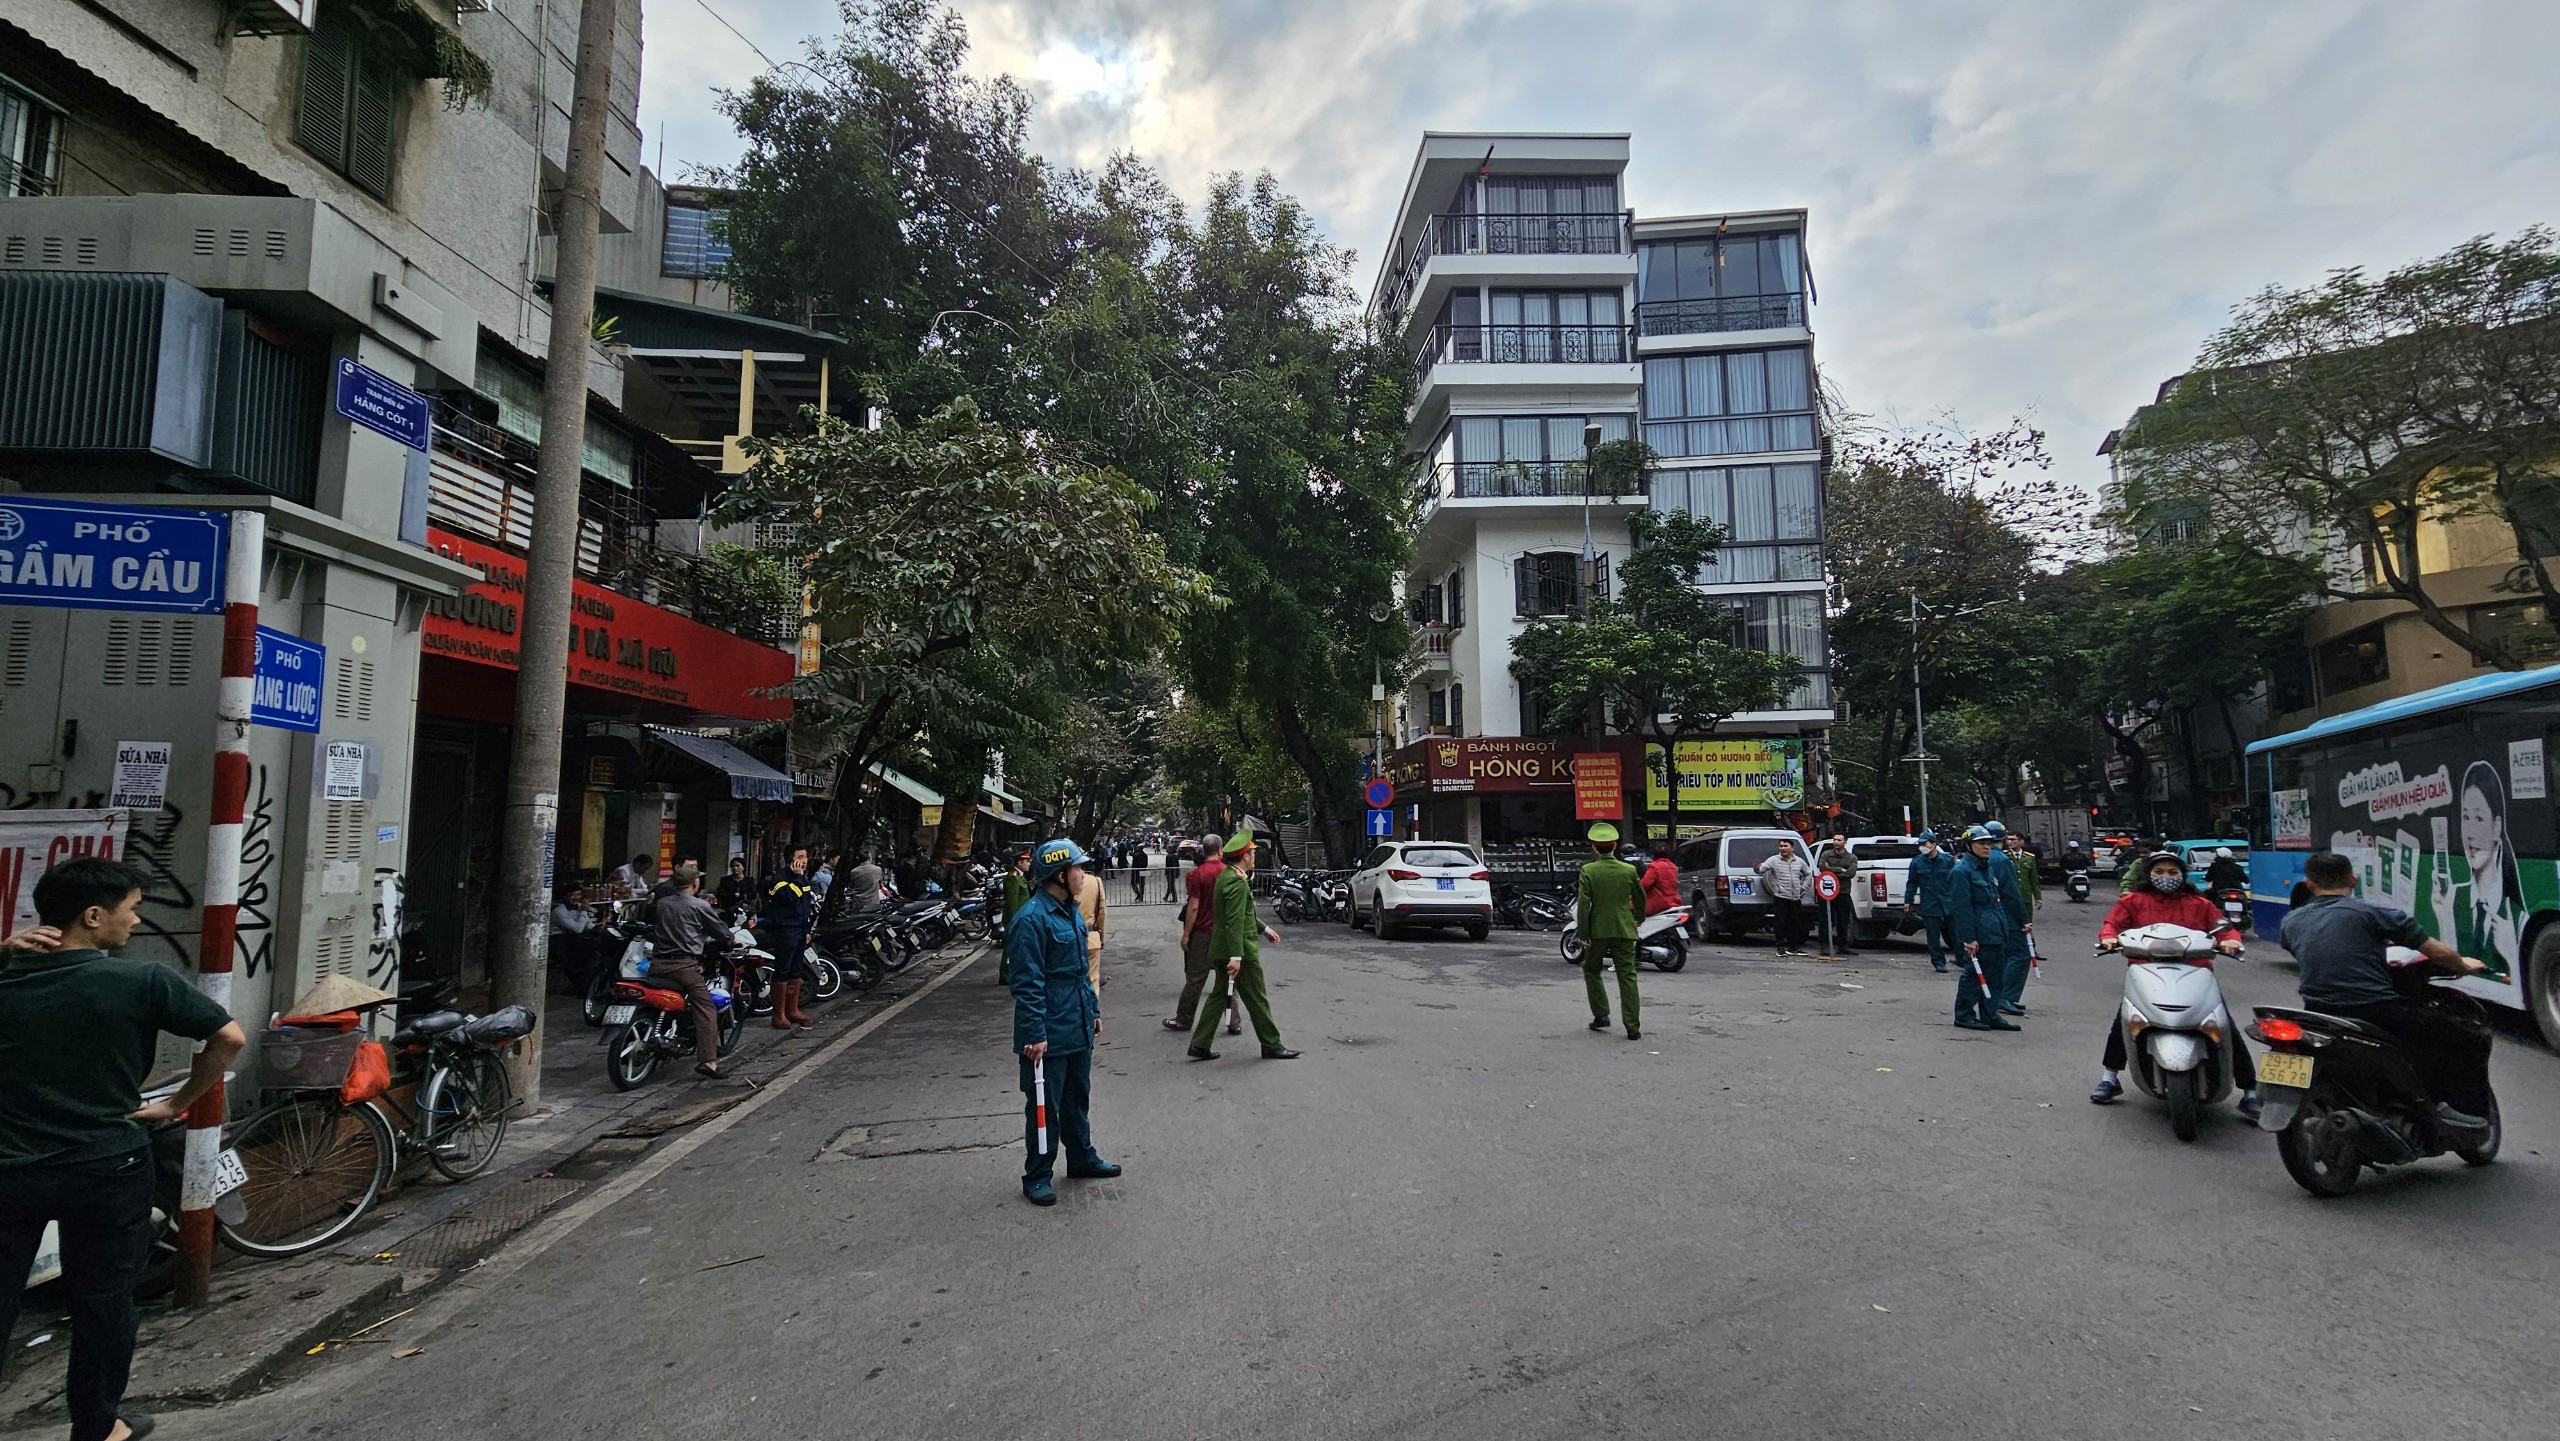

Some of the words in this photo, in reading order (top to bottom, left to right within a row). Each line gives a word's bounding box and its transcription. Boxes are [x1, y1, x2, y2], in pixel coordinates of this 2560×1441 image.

[354, 394, 384, 416] HÀNG
[409, 422, 414, 431] 1
[73, 519, 155, 543] PHỐ
[111, 548, 200, 593] CẦU
[584, 626, 611, 661] VÀ
[275, 649, 303, 670] PHỐ
[253, 667, 284, 709] ÀNG
[285, 681, 316, 719] LƯỢC
[119, 746, 142, 764] SỬA
[1467, 740, 1510, 753] BÁNH
[1705, 752, 1718, 763] CÔ
[1469, 754, 1540, 777] HỒNG
[2388, 770, 2400, 785] DA
[1044, 848, 1070, 864] DQTV
